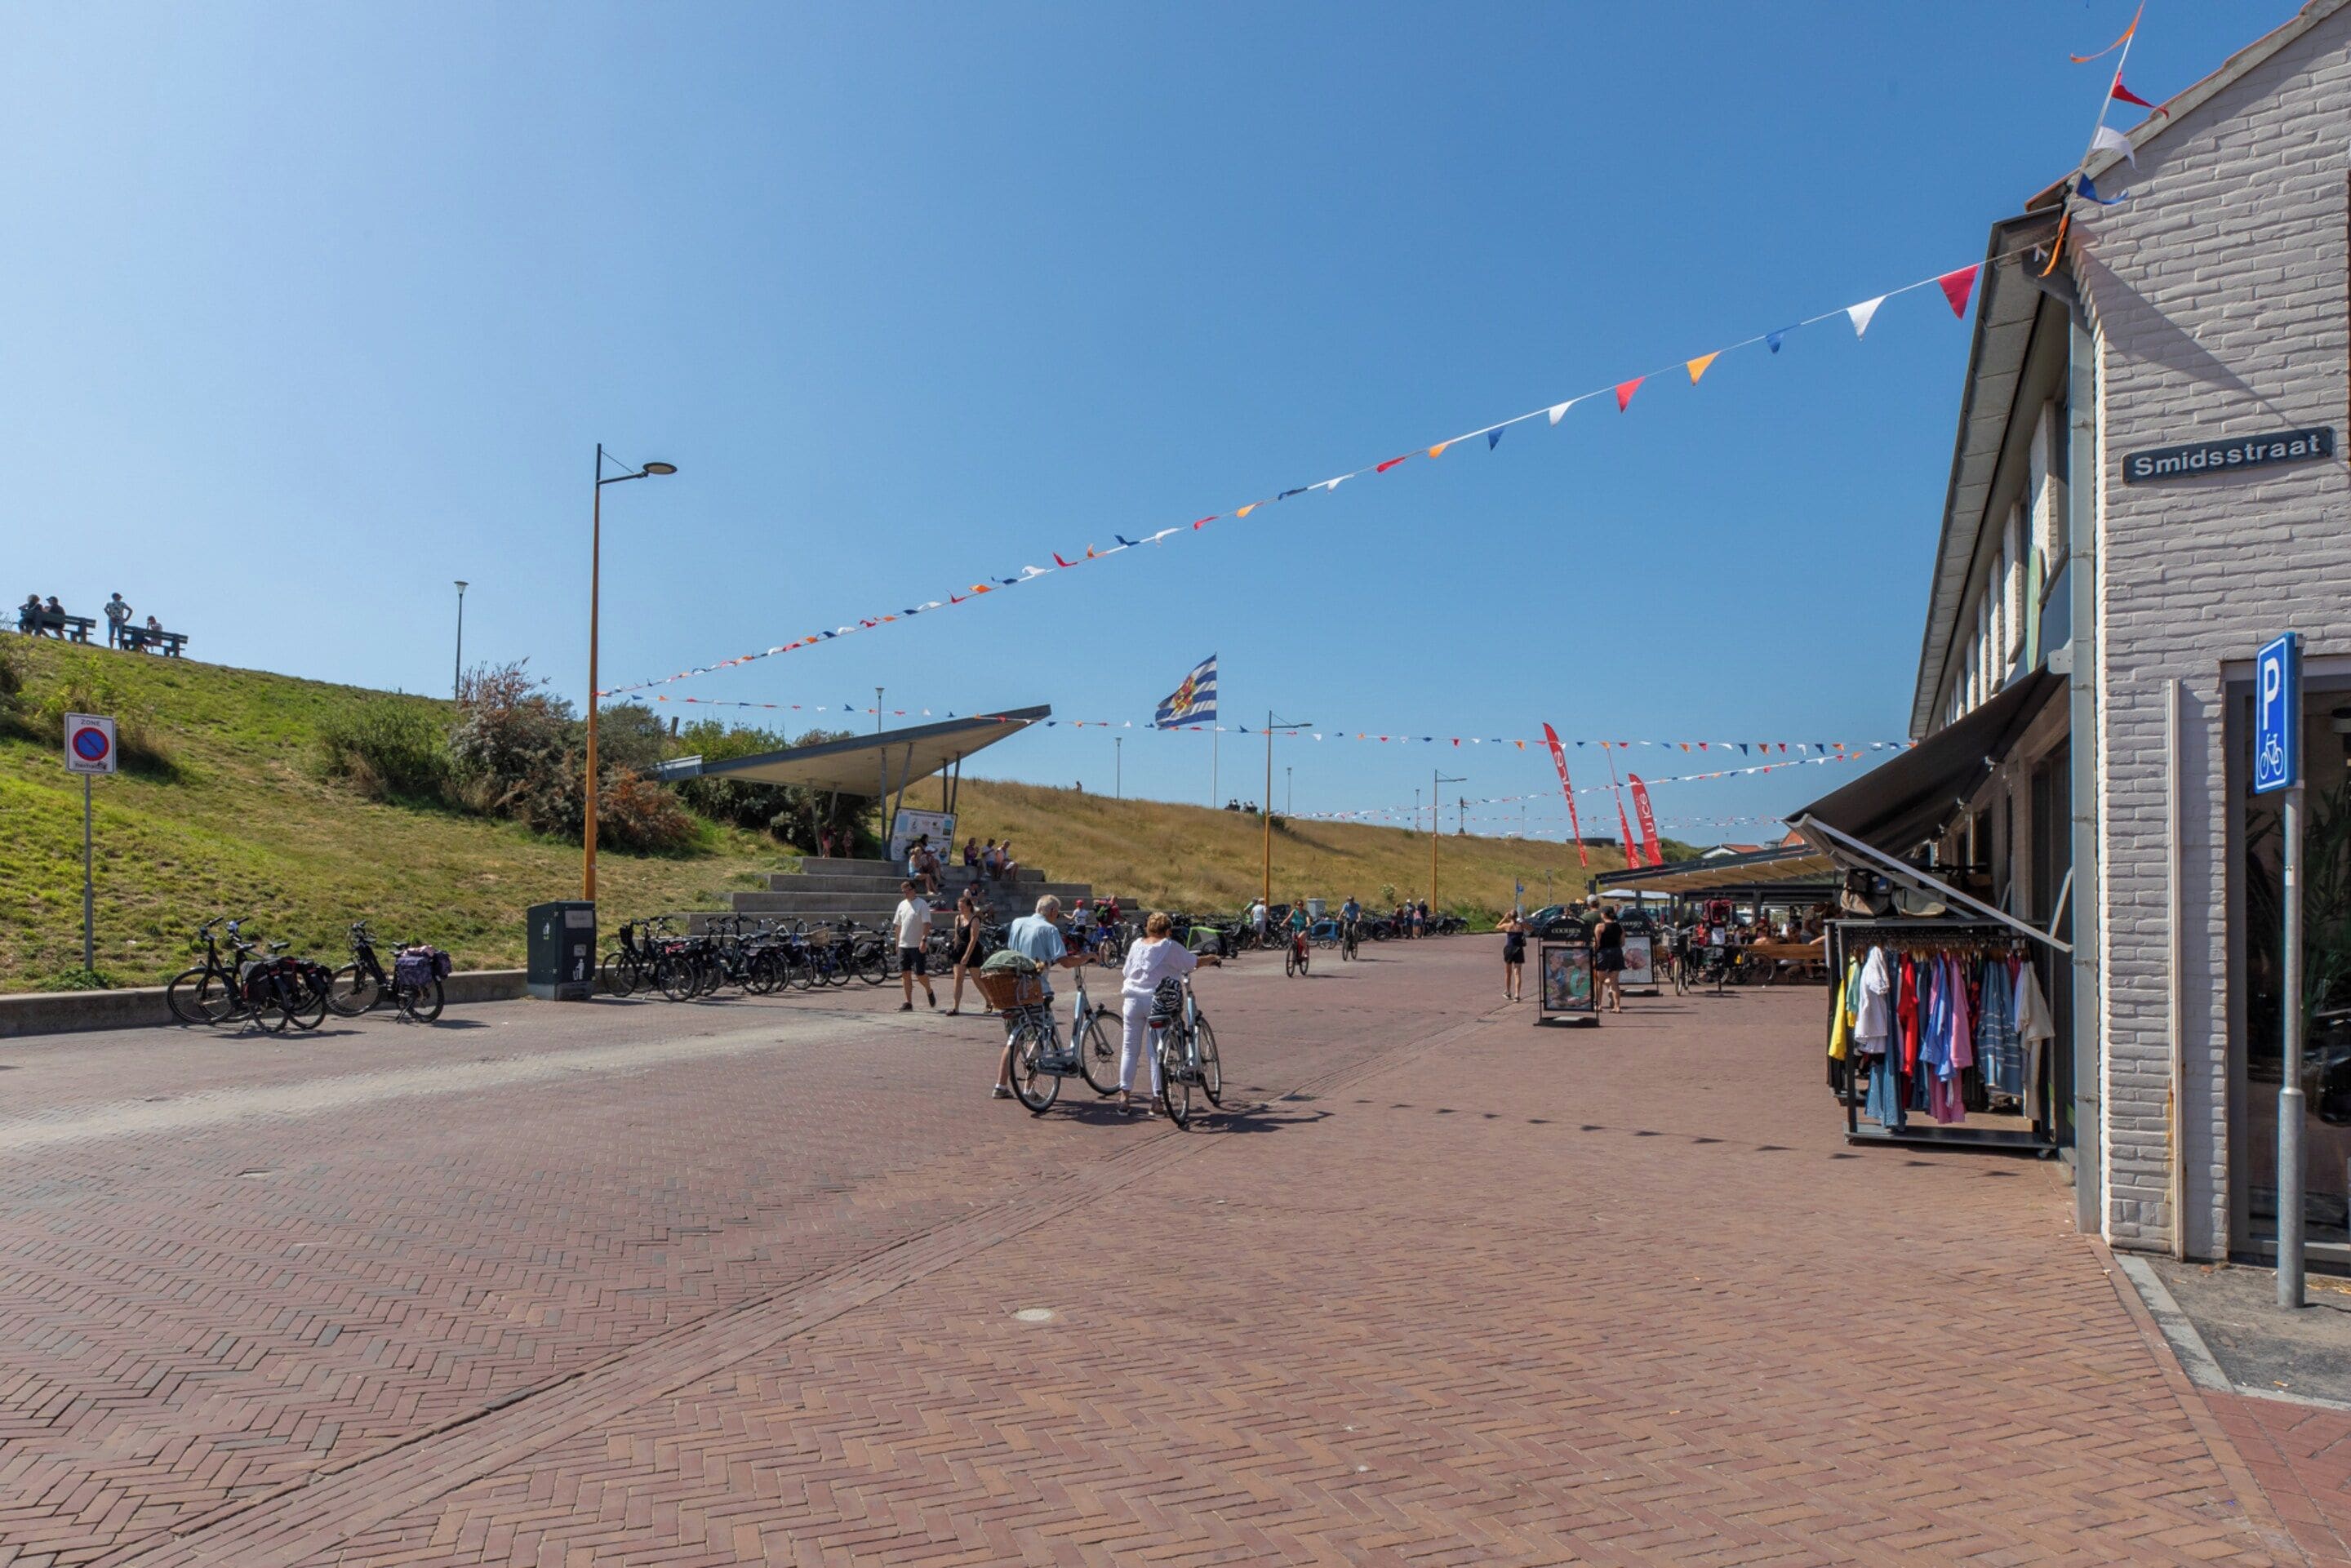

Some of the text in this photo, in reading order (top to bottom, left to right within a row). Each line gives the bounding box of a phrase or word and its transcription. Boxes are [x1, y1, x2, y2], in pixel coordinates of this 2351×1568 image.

[2135, 434, 2321, 476] Smidsstraat
[2263, 657, 2280, 731] P
[80, 718, 101, 726] ZONE
